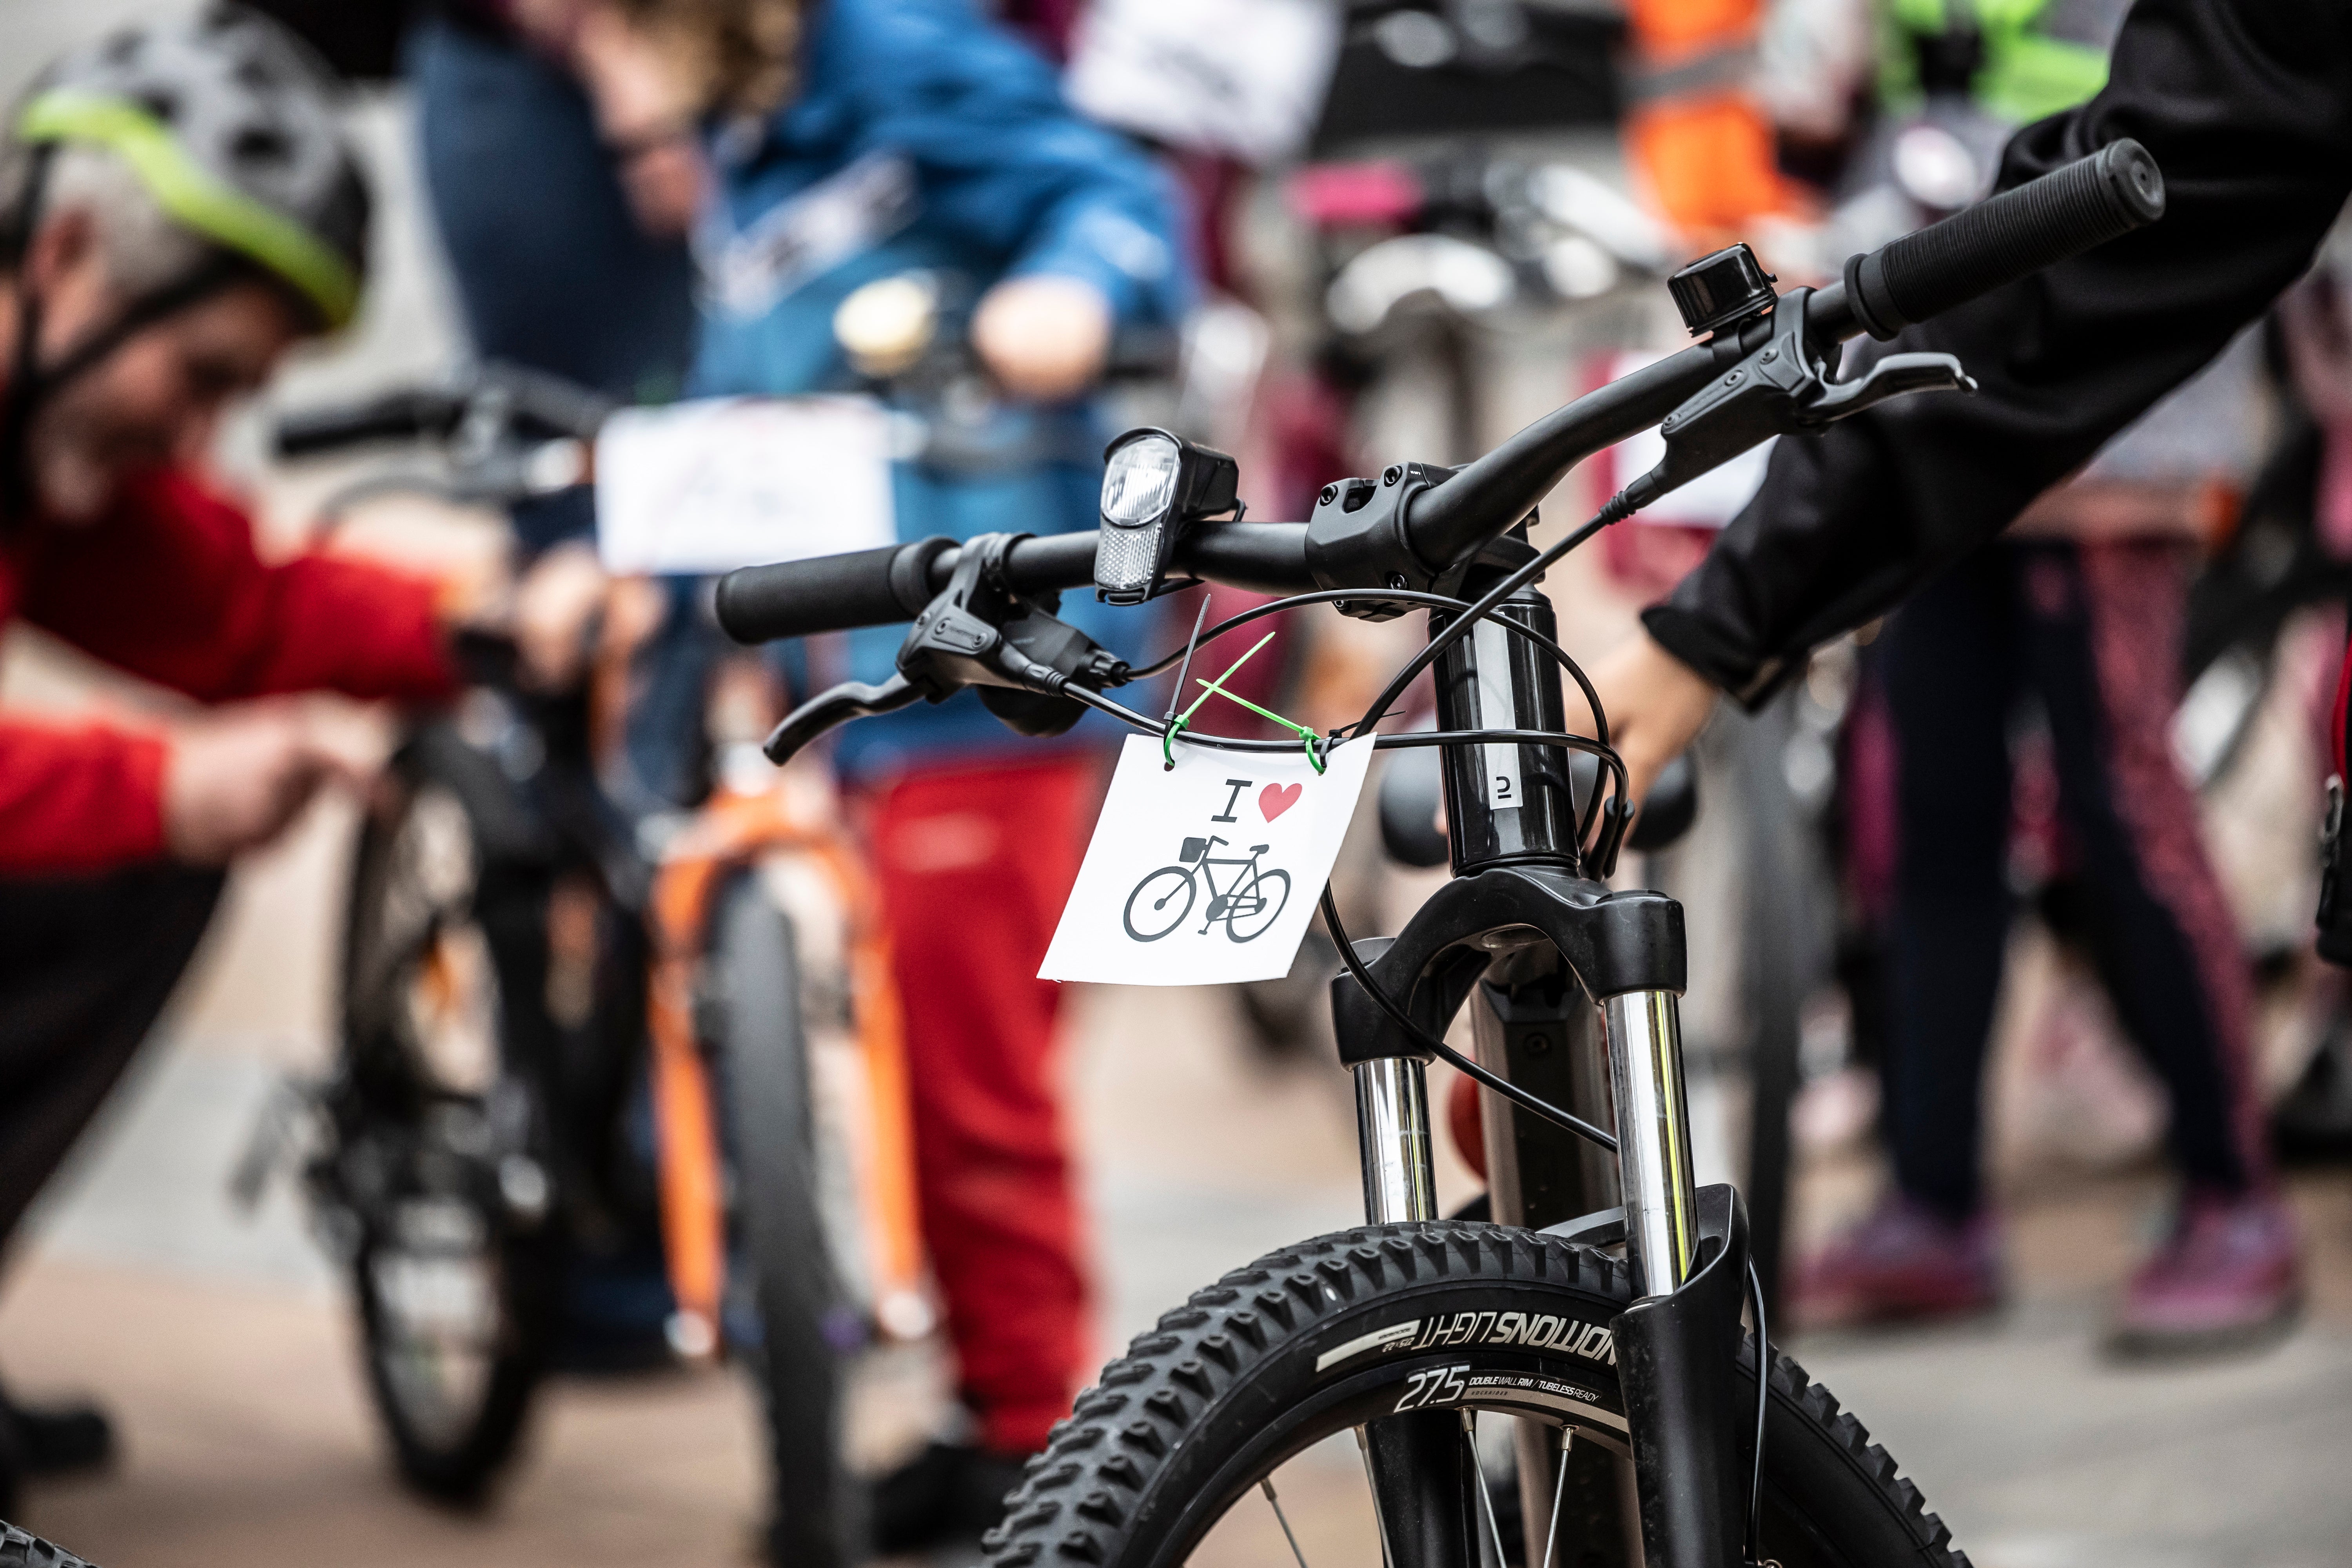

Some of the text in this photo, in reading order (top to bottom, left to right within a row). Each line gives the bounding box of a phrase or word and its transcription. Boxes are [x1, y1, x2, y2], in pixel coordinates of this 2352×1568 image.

[1211, 779, 1252, 823] I
[1411, 1312, 1497, 1350] LIGHT
[1469, 1376, 1499, 1386] DOUBLE
[1498, 1376, 1517, 1385] WALL
[1517, 1378, 1534, 1387] RIM
[1538, 1380, 1575, 1395] TUBELESS
[1573, 1389, 1599, 1402] READY
